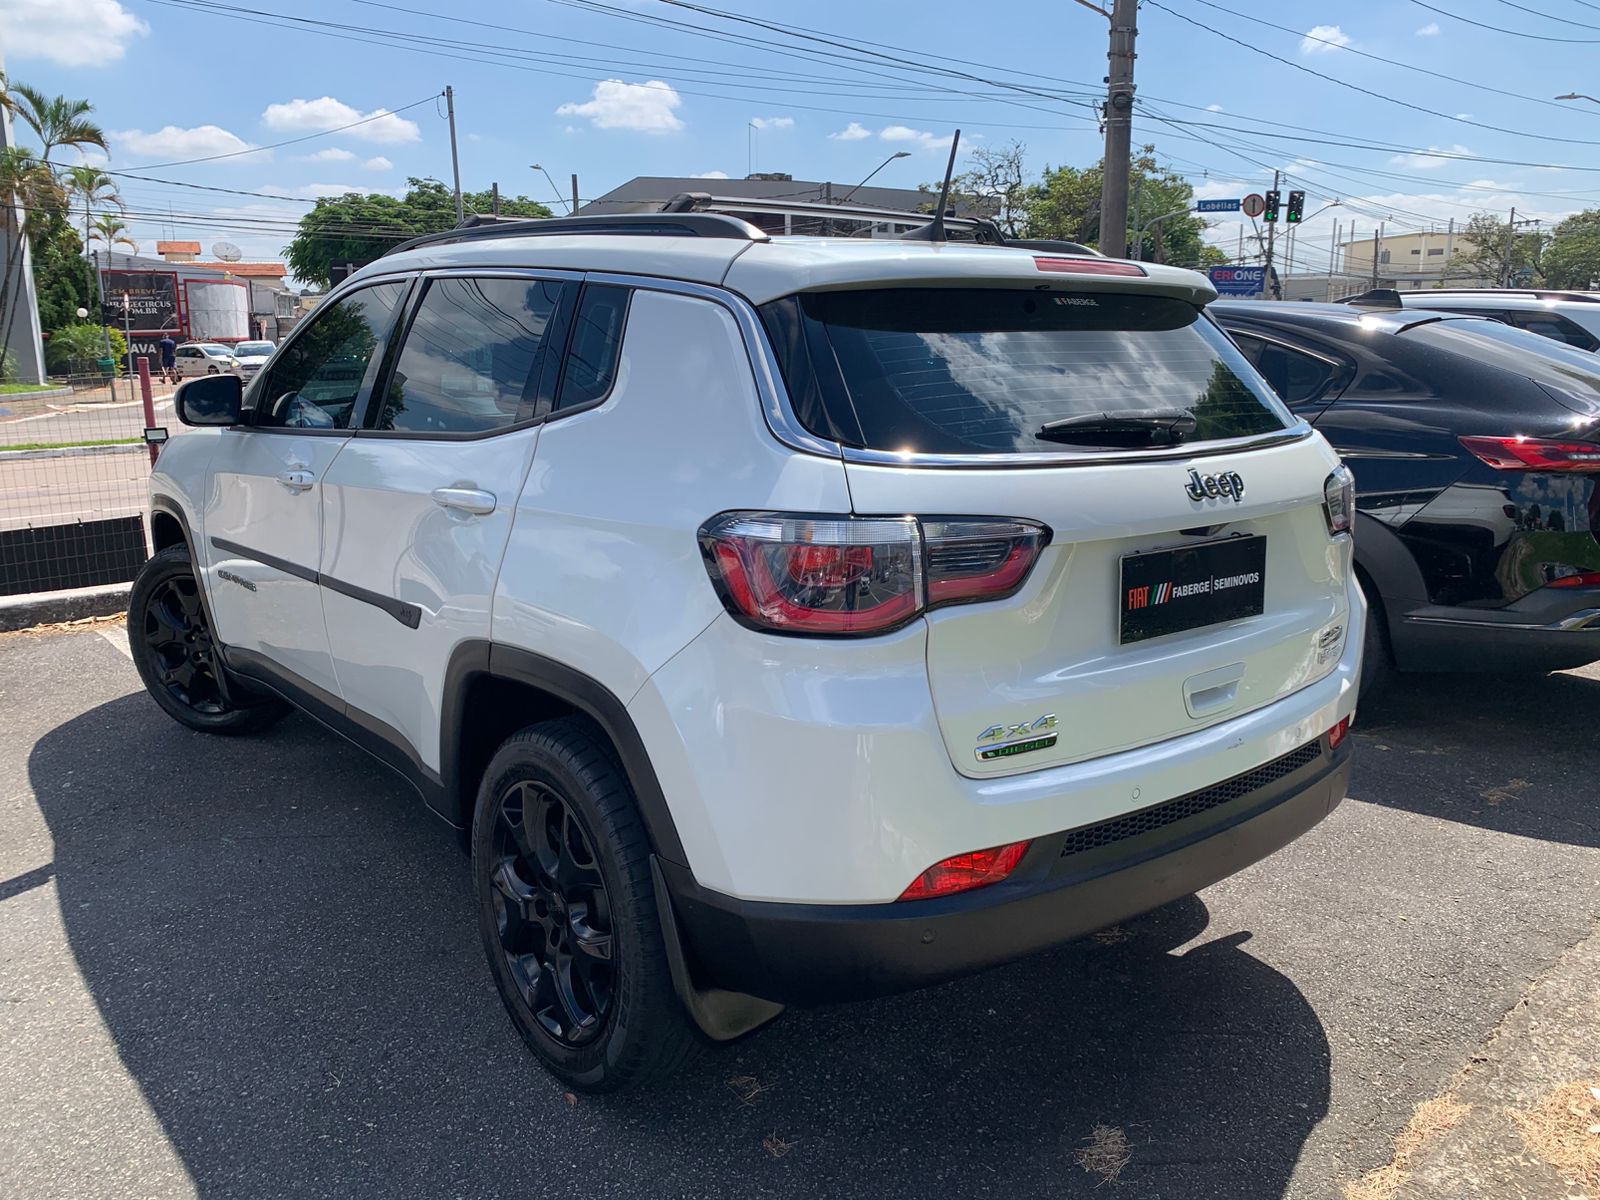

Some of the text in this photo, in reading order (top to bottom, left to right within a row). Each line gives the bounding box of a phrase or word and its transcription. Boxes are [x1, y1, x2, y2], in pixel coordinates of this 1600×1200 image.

[1213, 270, 1262, 281] ERIONE
[1184, 467, 1244, 502] Jeep
[1128, 572, 1260, 610] FIAT FABERGE SEMINOVOS
[999, 739, 1053, 756] DIESEL
